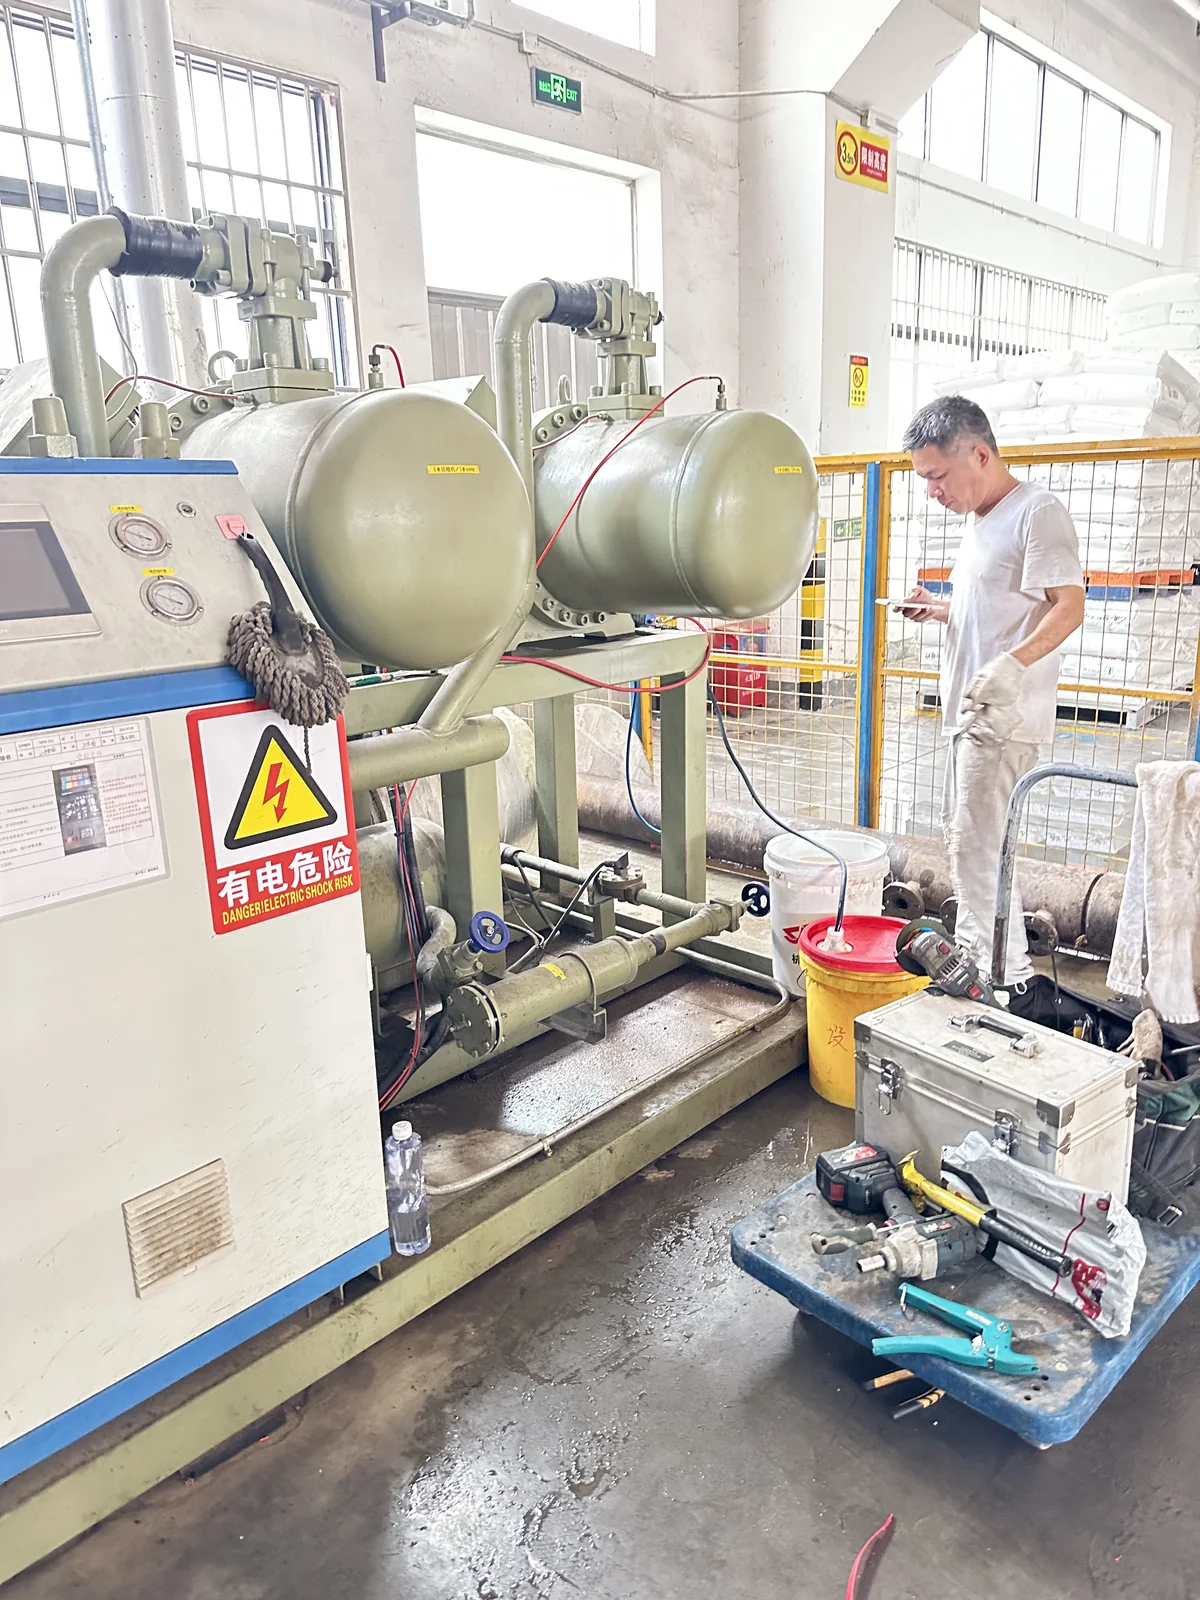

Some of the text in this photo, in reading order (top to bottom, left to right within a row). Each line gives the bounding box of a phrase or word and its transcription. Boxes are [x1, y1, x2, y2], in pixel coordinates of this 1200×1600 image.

[567, 88, 578, 102] EXIT
[216, 841, 354, 908] 有电危险
[306, 880, 334, 899] SHOCK
[335, 874, 354, 891] RISK
